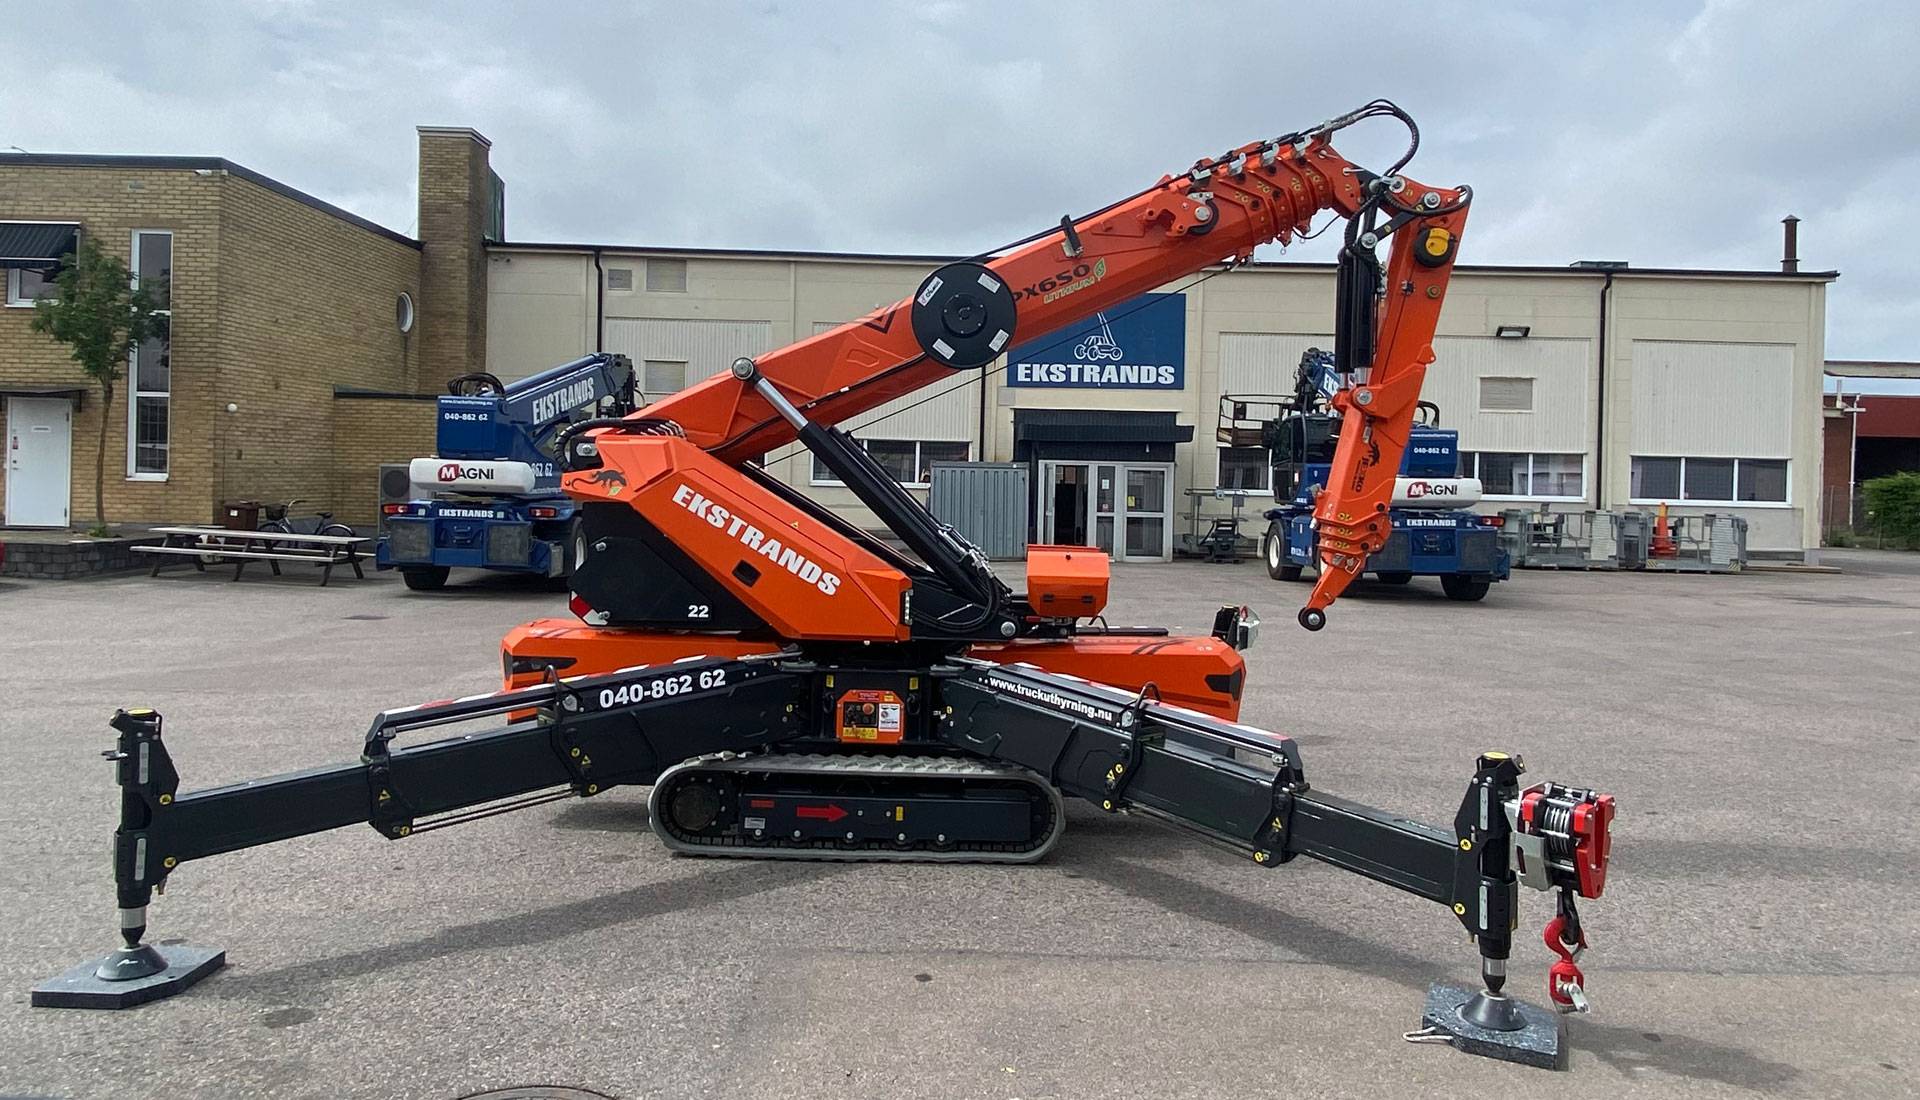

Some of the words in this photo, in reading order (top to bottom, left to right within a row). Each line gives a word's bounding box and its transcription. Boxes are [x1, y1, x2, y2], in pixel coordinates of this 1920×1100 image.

[1017, 363, 1176, 386] EKSTRANDS
[532, 377, 594, 425] EKSTRANDS
[444, 412, 476, 421] 040-862
[478, 413, 488, 421] 62
[439, 465, 494, 480] MAGNI
[545, 462, 553, 477] 62
[1408, 483, 1458, 496] MAGNI
[438, 508, 494, 518] EKSTRANDS
[1406, 519, 1457, 527] EKSTRANDS
[672, 483, 842, 596] EKSTRANDS
[687, 605, 709, 618] 22
[599, 674, 693, 709] 040-862
[699, 668, 726, 690] 62
[989, 676, 1113, 722] www.truckuthyrning.nu
